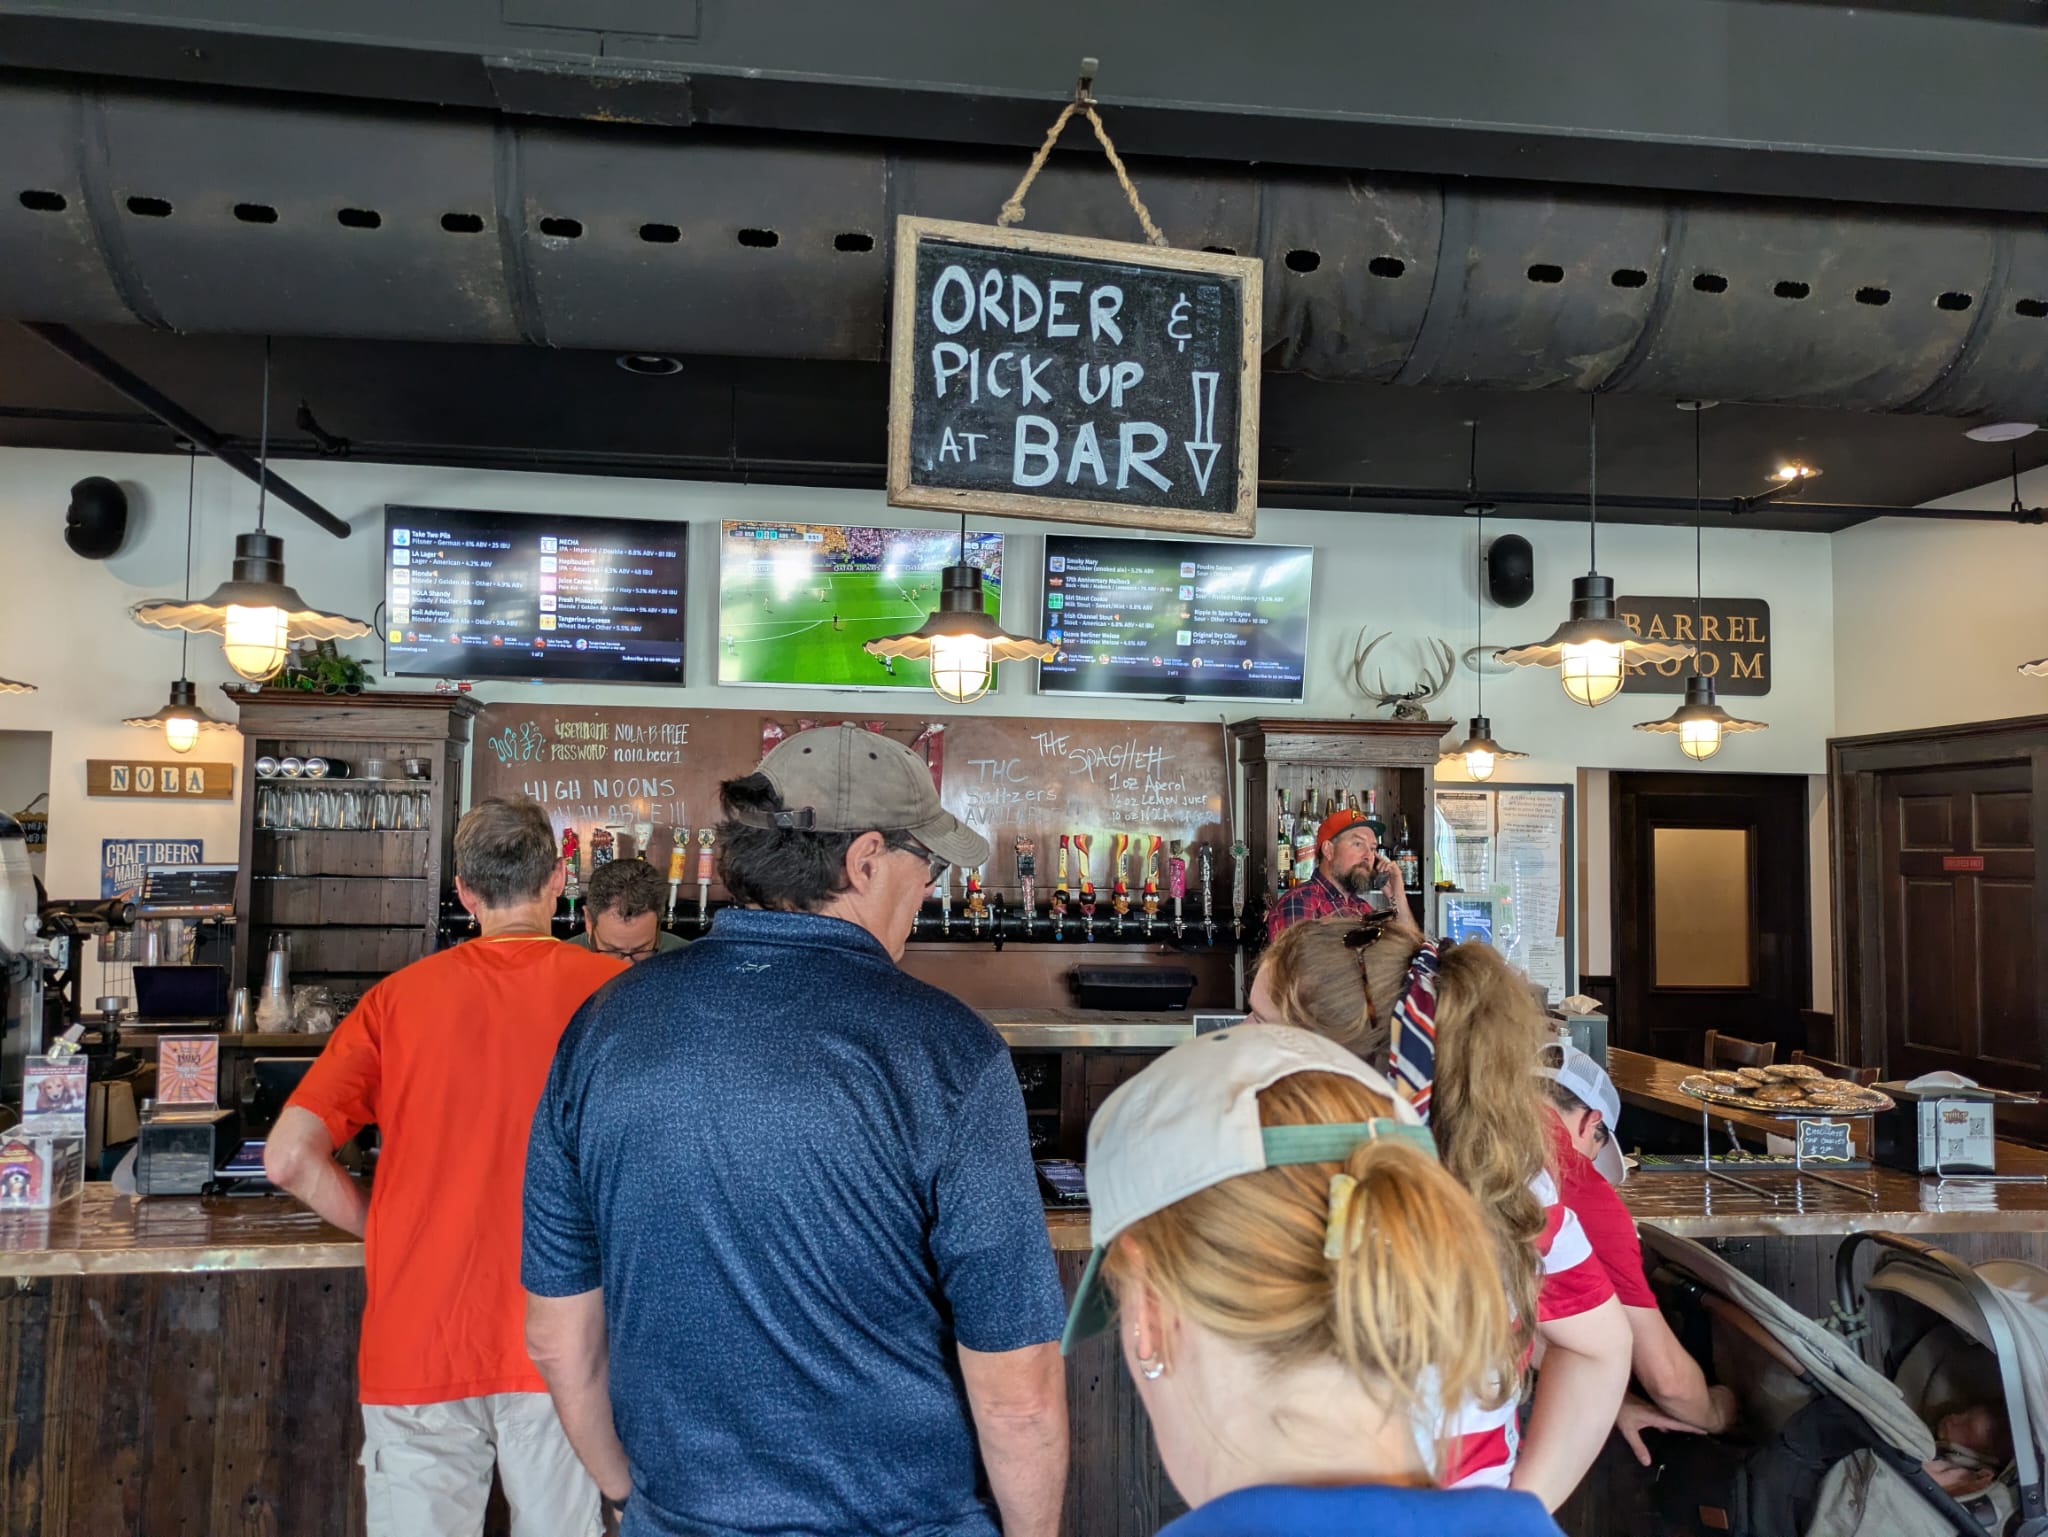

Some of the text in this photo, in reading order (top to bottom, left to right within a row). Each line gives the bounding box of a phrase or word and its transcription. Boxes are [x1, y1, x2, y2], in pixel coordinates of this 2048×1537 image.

[932, 265, 1193, 353] ORDER &
[932, 342, 1144, 408] PICK UP
[938, 414, 1174, 492] AT BAR
[1620, 613, 1766, 643] BARREL
[1030, 730, 1070, 756] THE
[112, 766, 204, 792] NOLA
[968, 758, 1028, 784] THC
[593, 778, 676, 798] NOONS
[106, 843, 199, 868] CRAFT BEERS
[114, 863, 144, 883] MADE
